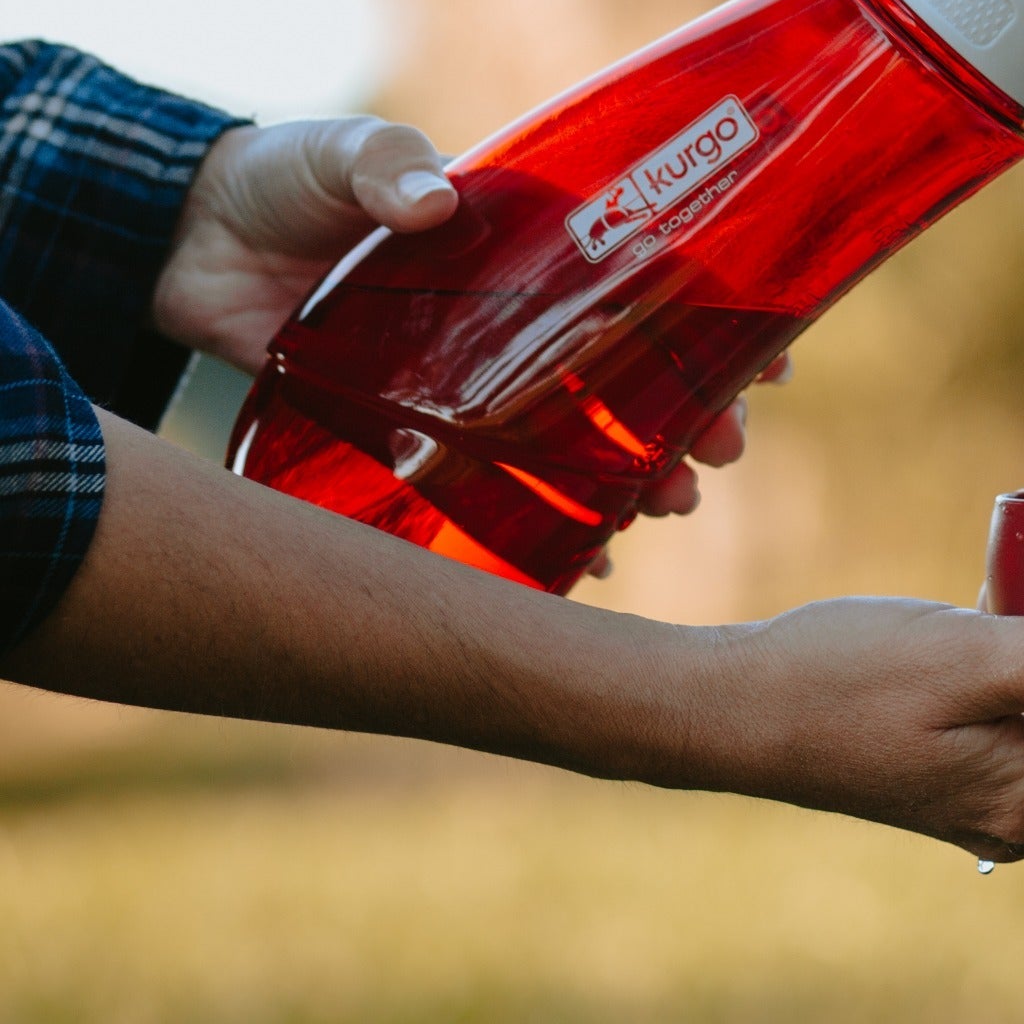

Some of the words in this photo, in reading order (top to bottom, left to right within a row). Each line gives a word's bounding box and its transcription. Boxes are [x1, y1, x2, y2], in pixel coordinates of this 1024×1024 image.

[643, 117, 738, 195] kurgo
[632, 234, 656, 258] go
[658, 170, 738, 234] together
